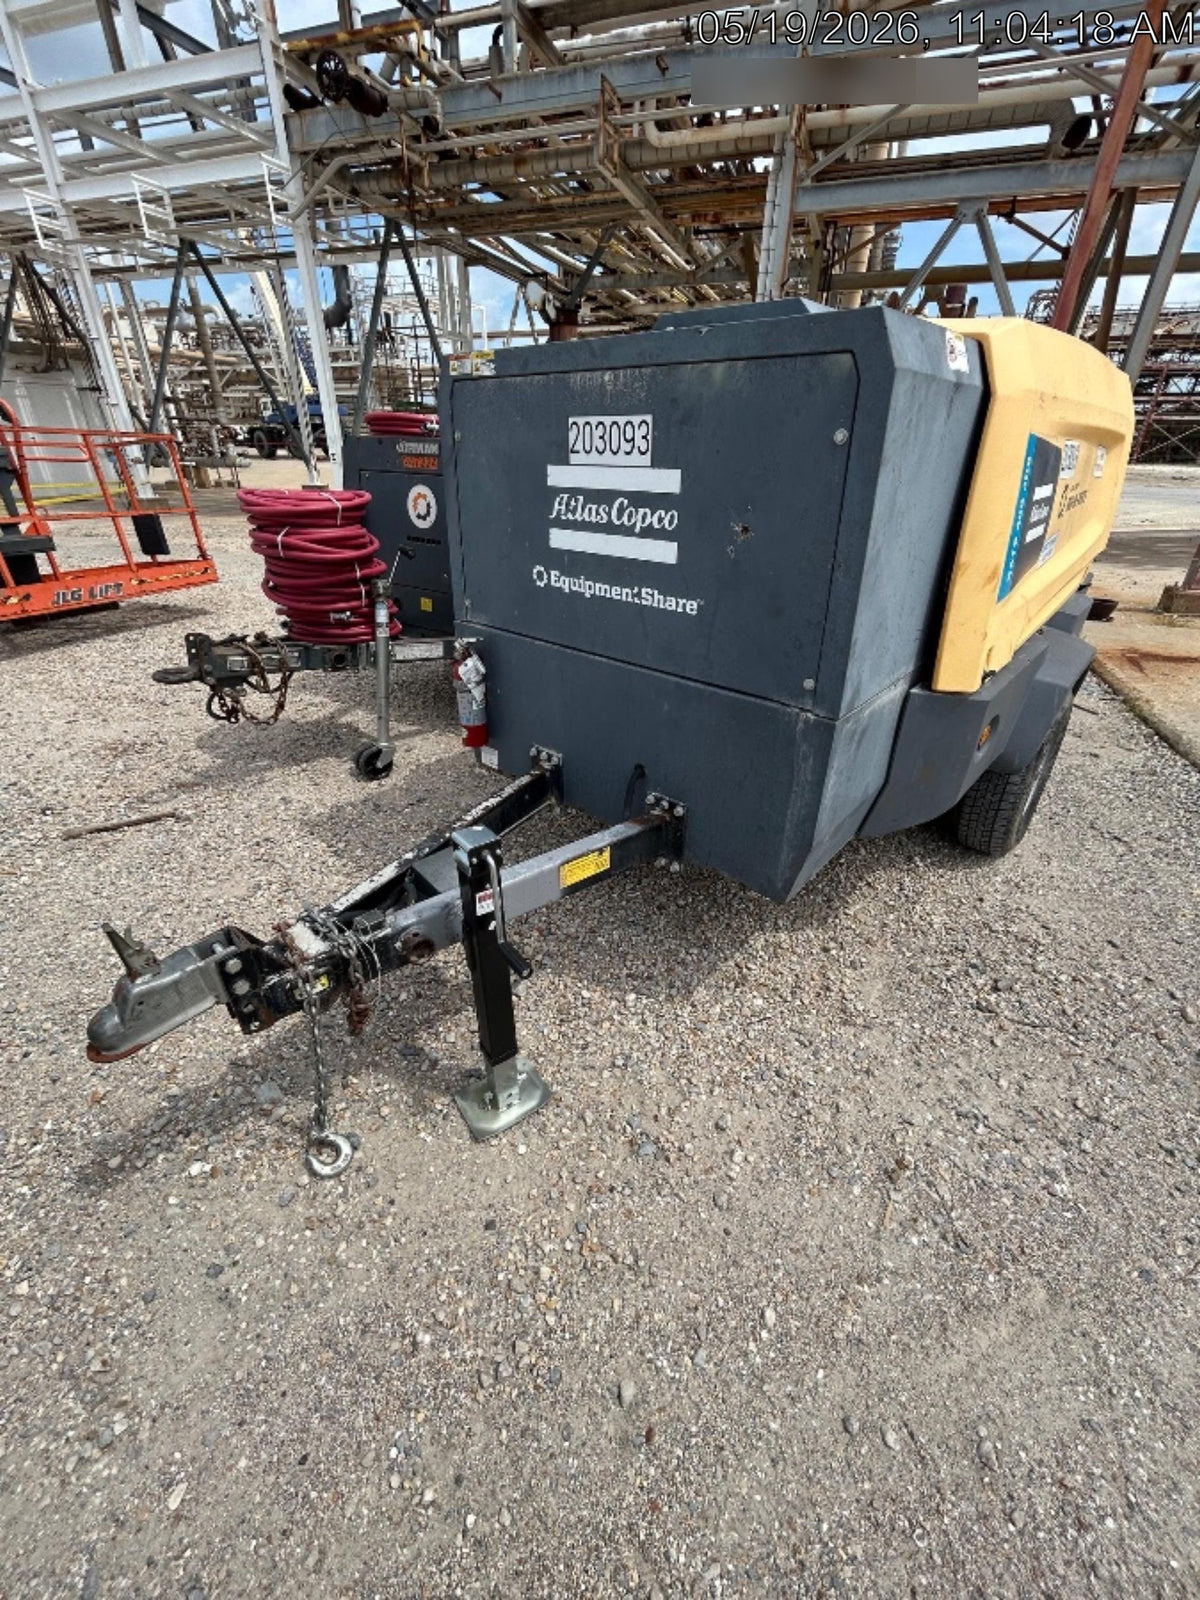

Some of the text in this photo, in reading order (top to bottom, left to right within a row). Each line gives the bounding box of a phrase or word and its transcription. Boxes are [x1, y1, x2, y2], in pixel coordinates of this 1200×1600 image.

[570, 420, 649, 454] 203093
[549, 493, 678, 532] Atlas Copco
[52, 582, 123, 606] JLG LIFT
